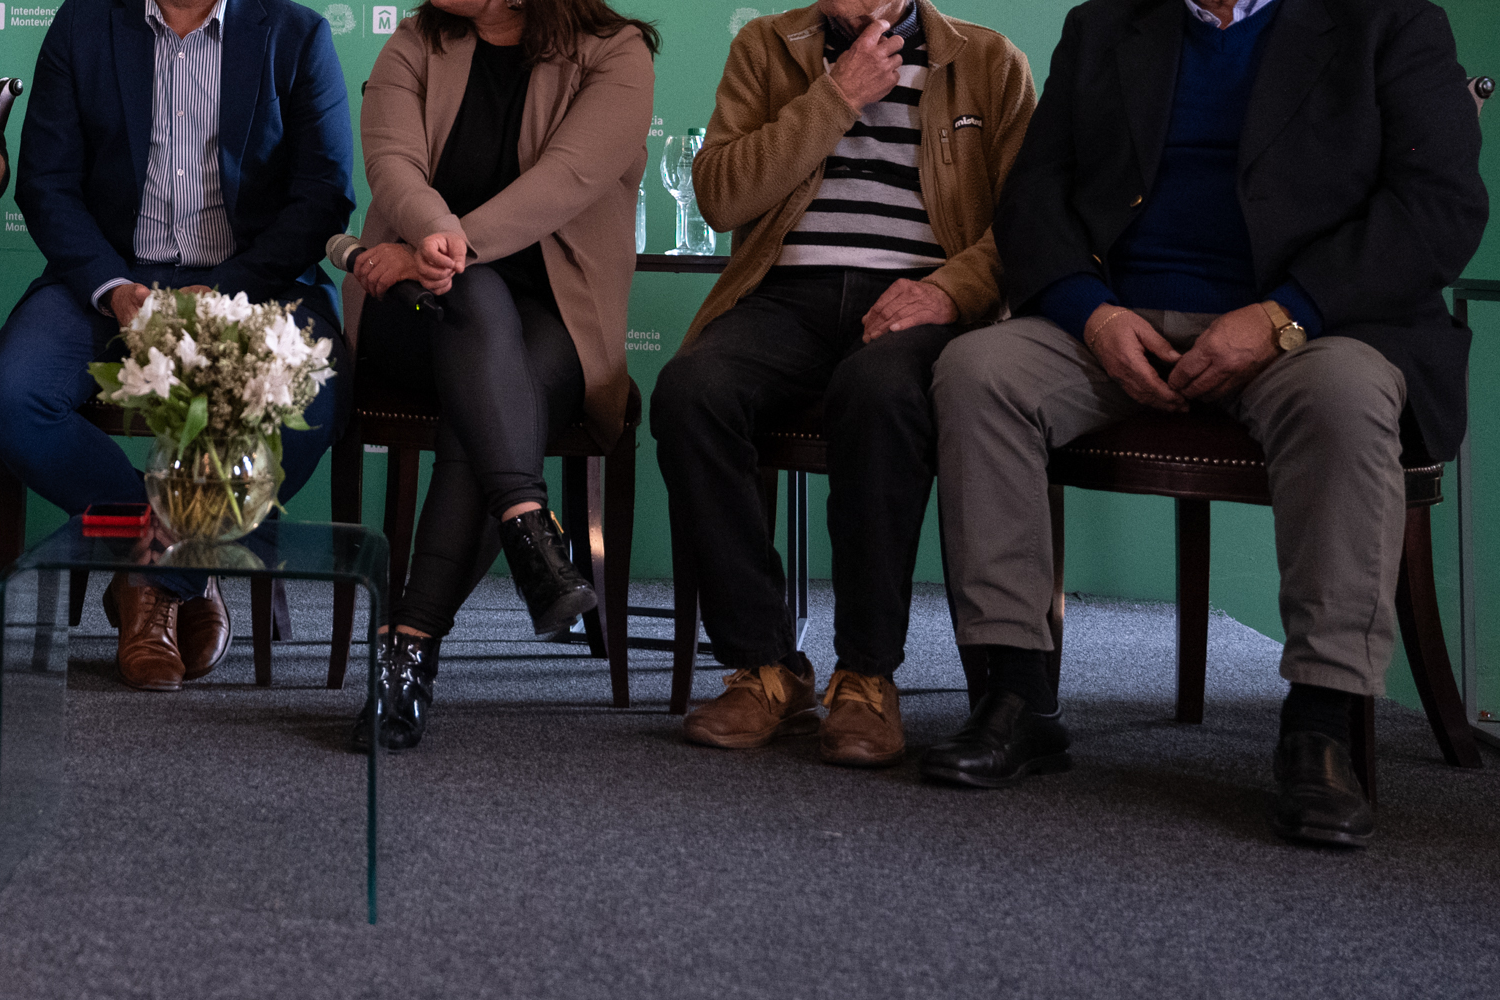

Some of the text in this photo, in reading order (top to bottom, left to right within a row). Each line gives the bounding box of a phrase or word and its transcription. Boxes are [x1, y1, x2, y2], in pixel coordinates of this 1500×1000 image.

[10, 6, 58, 16] Intendenc
[10, 16, 54, 27] Montevid
[954, 116, 983, 128] mistra
[626, 328, 661, 340] dencia
[624, 340, 661, 351] tevideo
